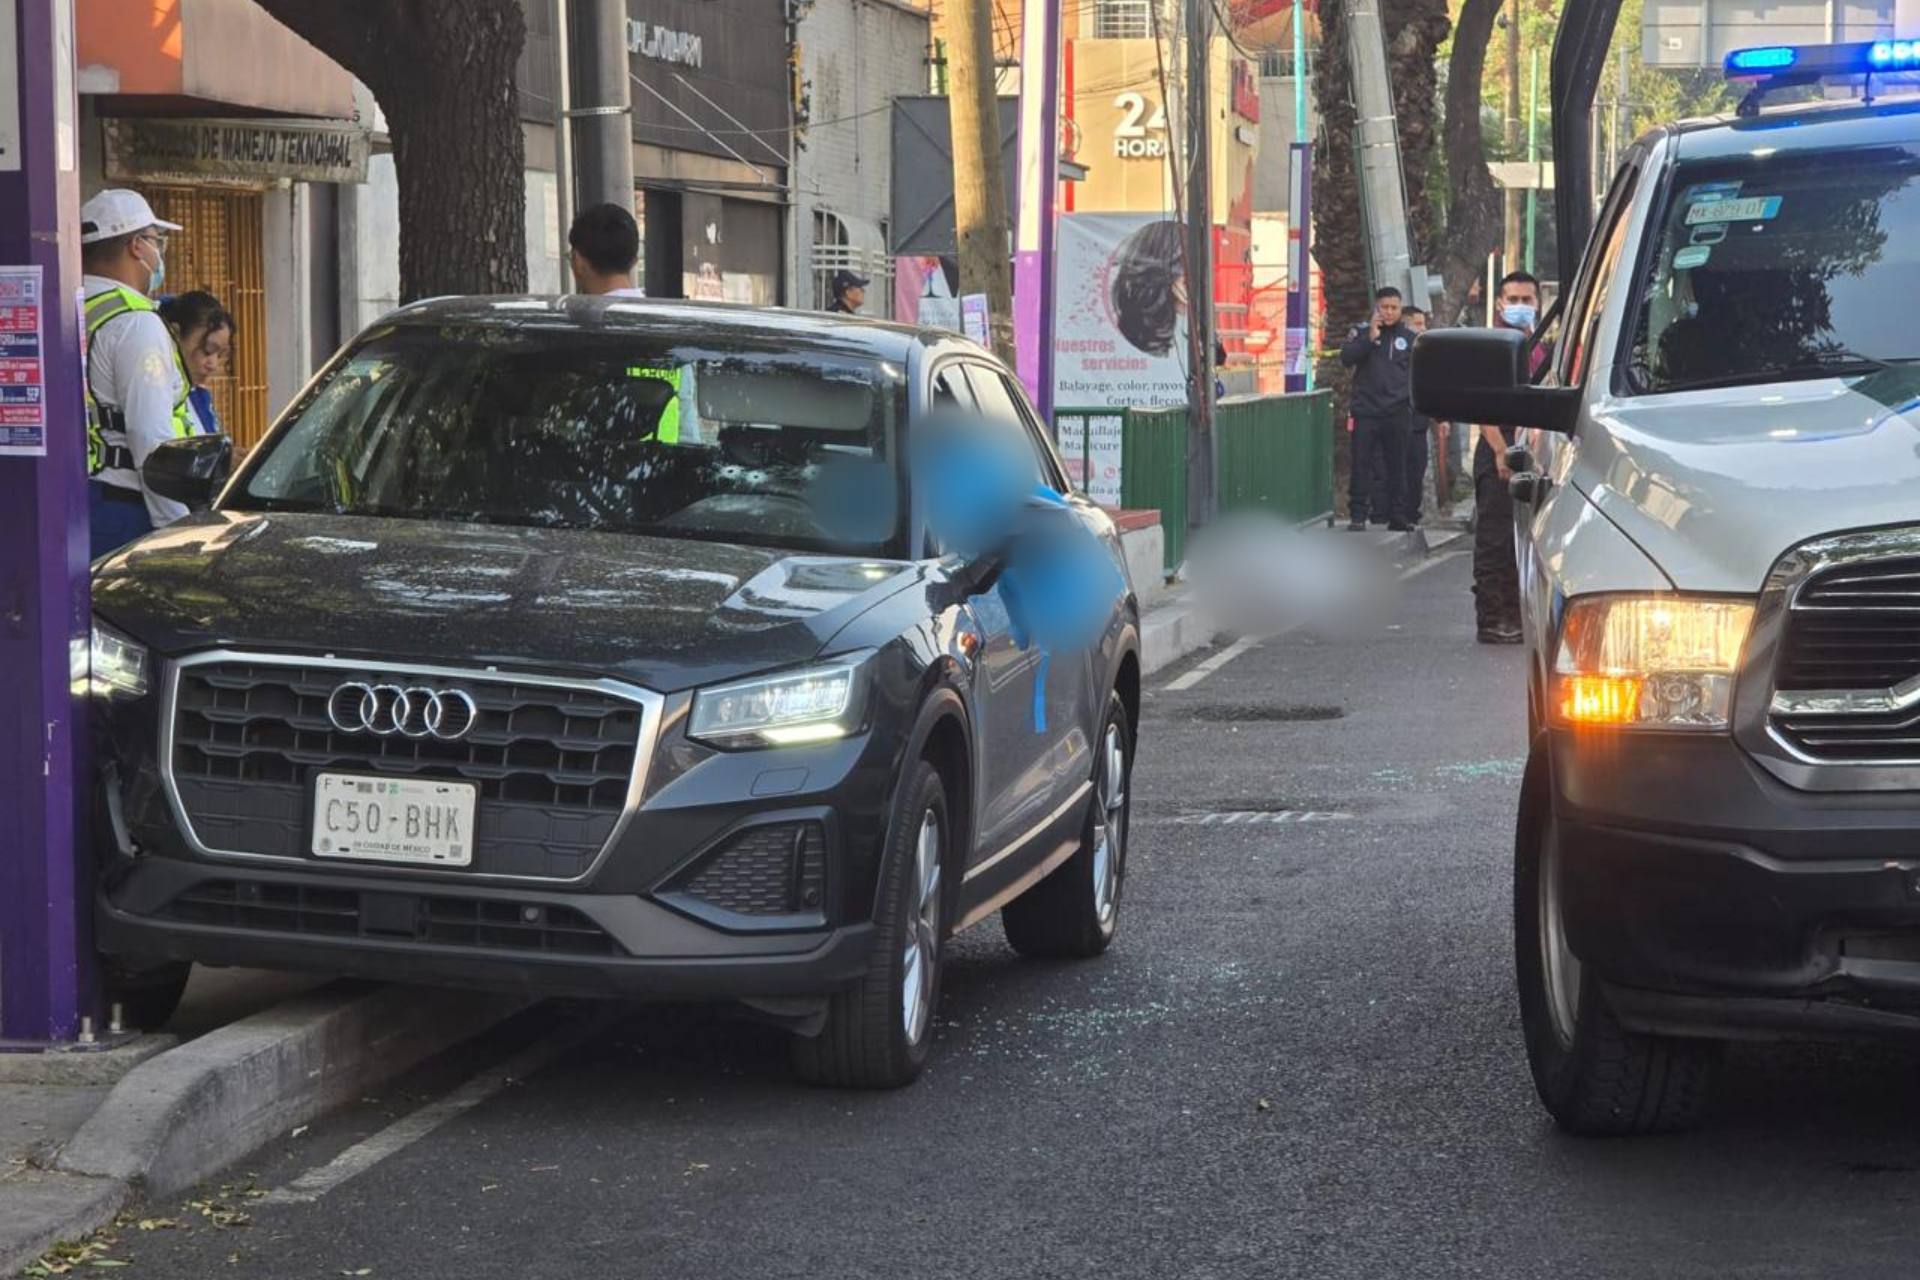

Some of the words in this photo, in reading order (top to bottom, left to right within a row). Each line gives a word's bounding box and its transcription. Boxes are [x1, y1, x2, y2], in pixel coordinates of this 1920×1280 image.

[202, 126, 218, 160] DE
[222, 128, 276, 163] MANEJO
[1114, 138, 1188, 157] HOR
[1080, 356, 1148, 370] servicios
[1064, 441, 1119, 451] Maicure
[326, 798, 461, 842] C50-BHK
[363, 842, 391, 851] CIUDAD
